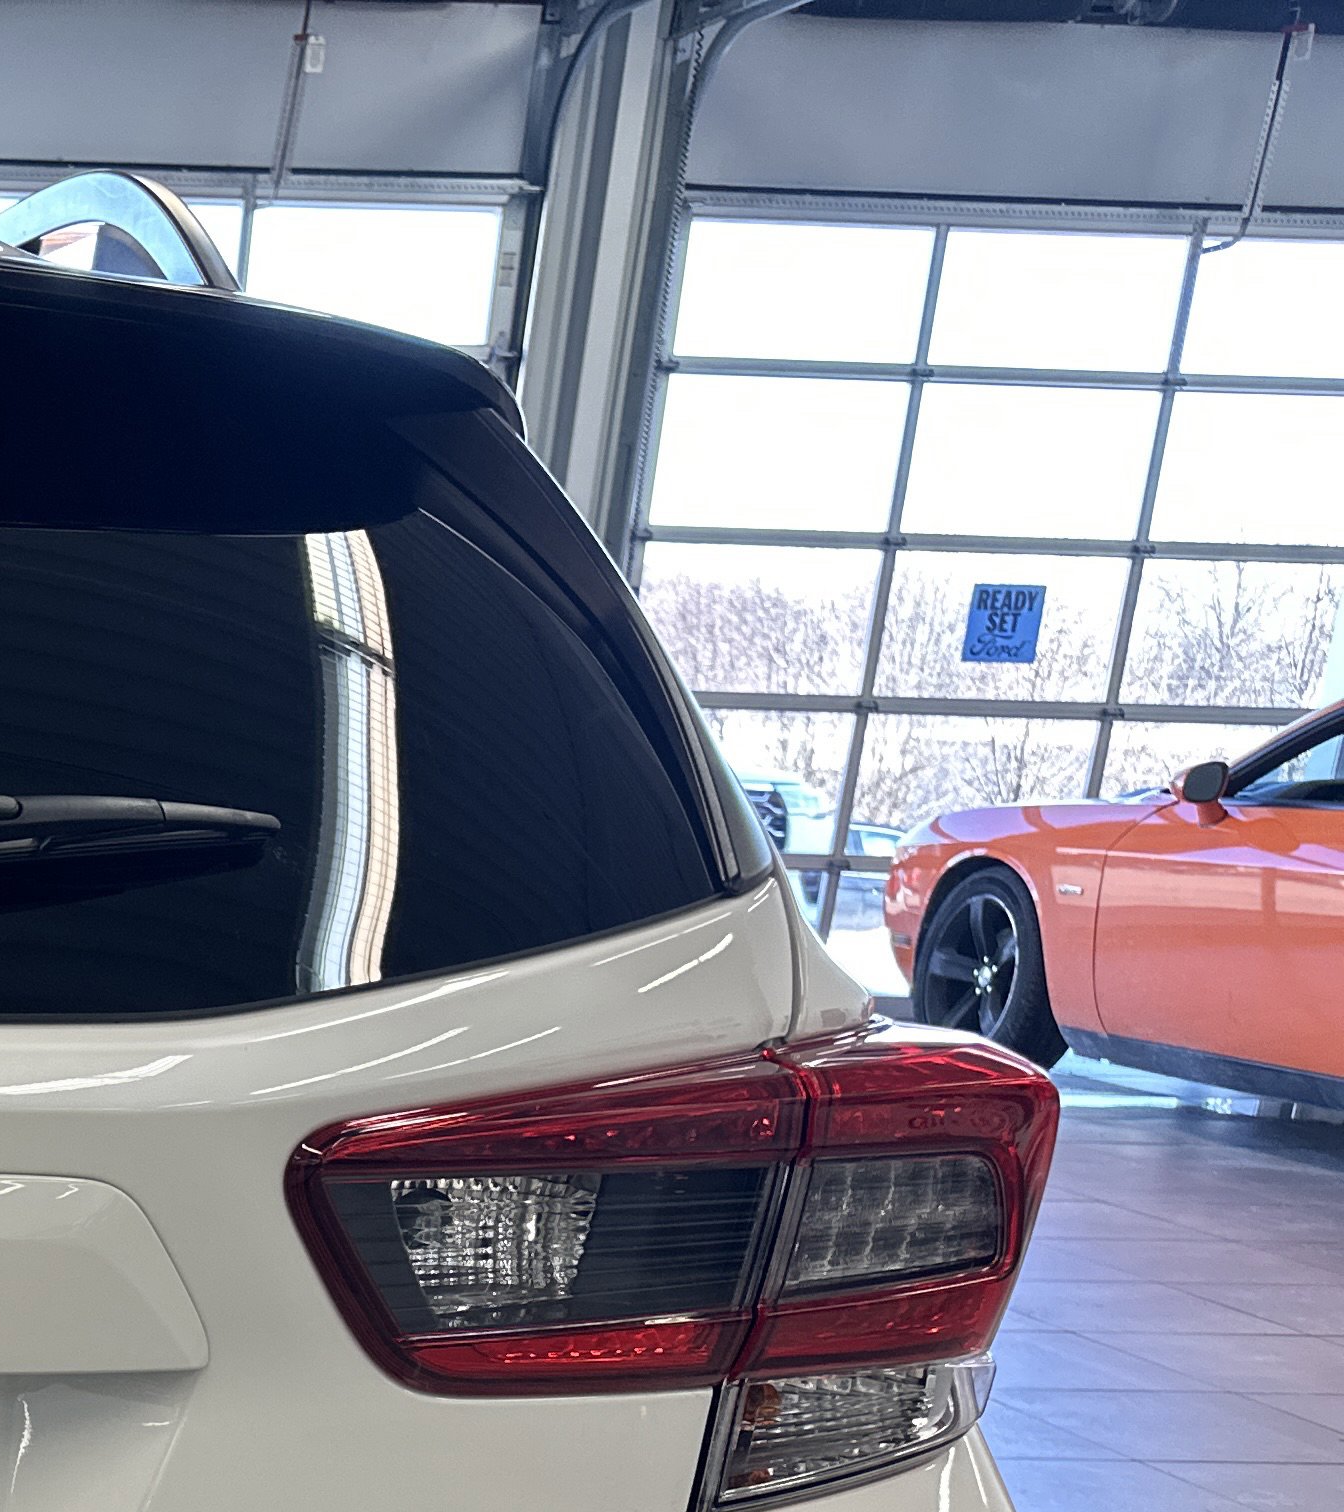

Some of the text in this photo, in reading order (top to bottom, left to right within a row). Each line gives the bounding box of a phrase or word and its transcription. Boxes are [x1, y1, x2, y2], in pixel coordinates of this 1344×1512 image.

[976, 589, 1039, 612] READY
[985, 612, 1021, 633] SET
[969, 632, 1031, 657] Ford
